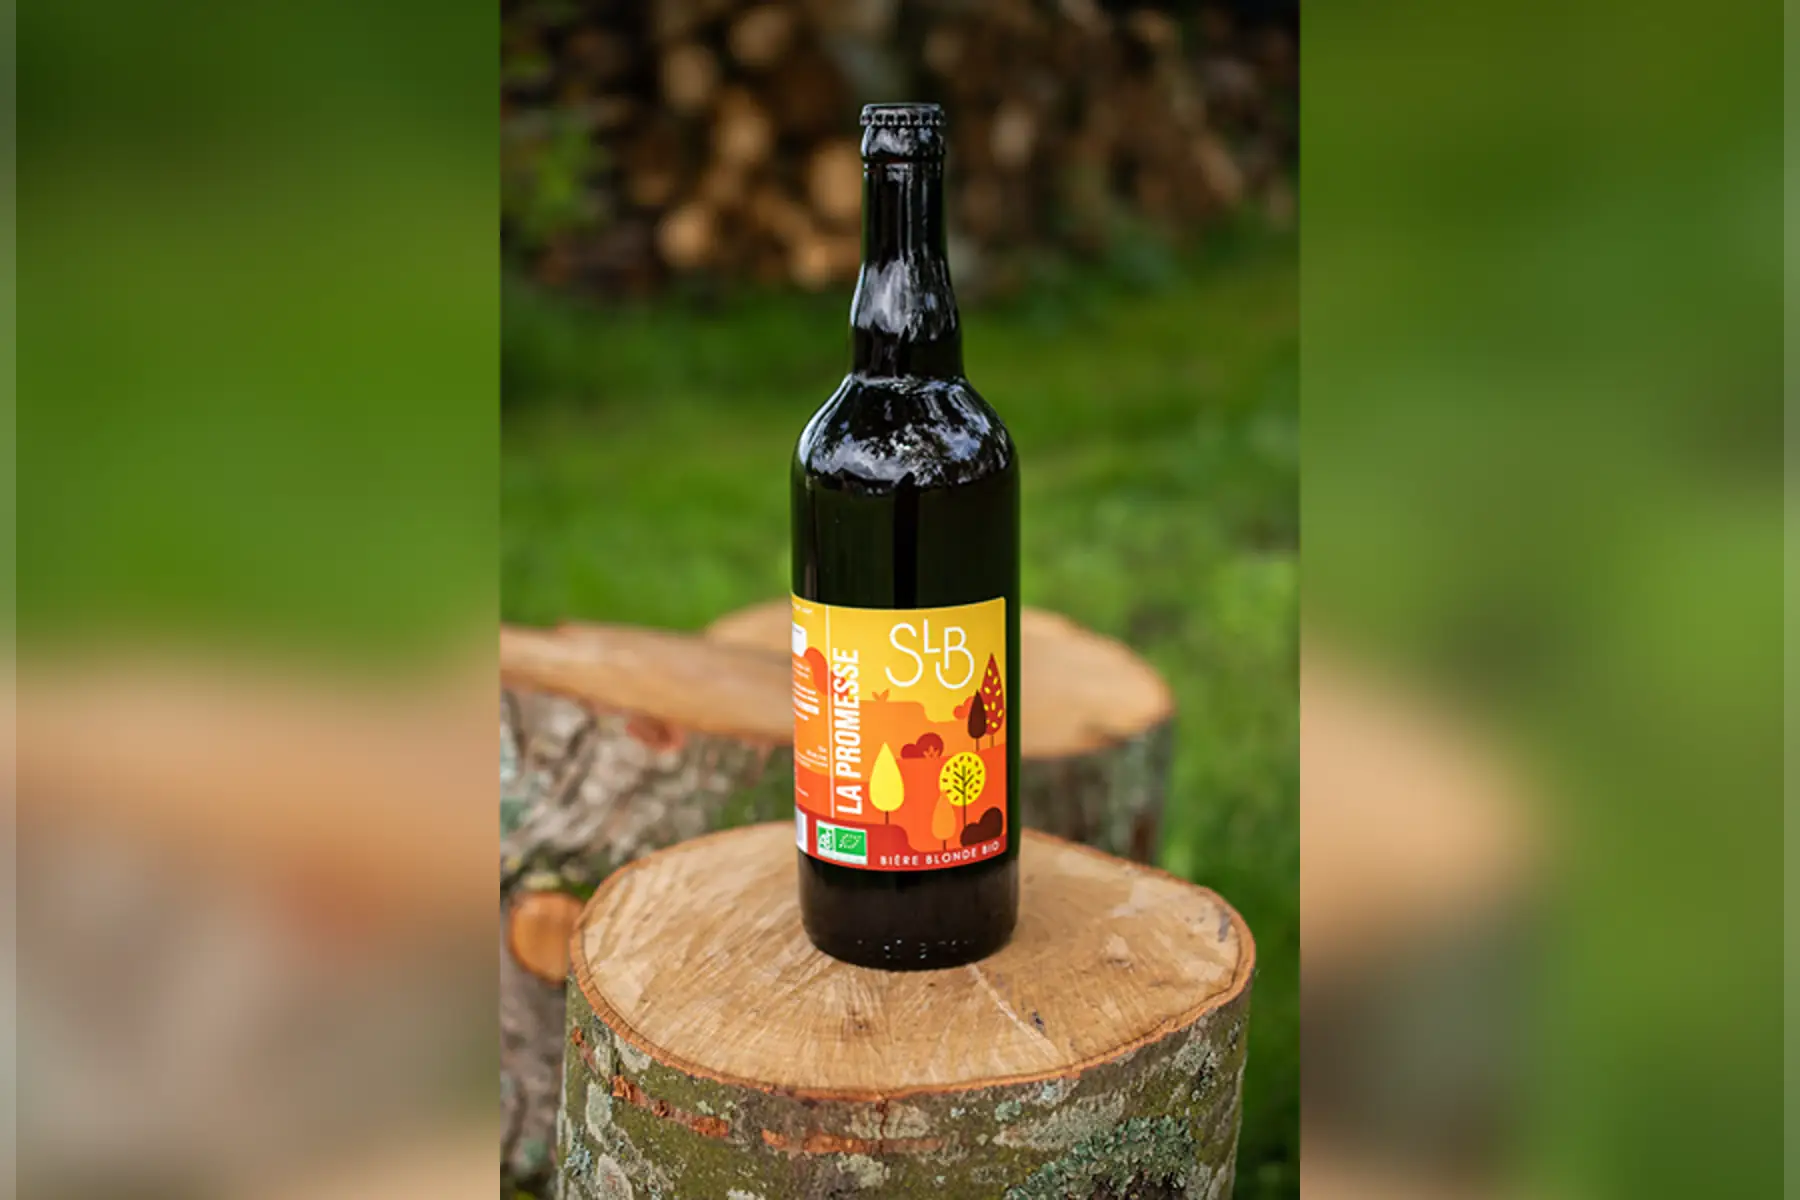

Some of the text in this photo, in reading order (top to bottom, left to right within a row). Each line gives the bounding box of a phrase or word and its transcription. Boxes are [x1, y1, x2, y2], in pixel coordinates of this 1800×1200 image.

[885, 618, 975, 689] SLB
[833, 648, 862, 814] LA PROMESSE
[880, 854, 919, 866] BIÈRE
[925, 848, 977, 864] BLONDE
[982, 841, 999, 855] BIO
